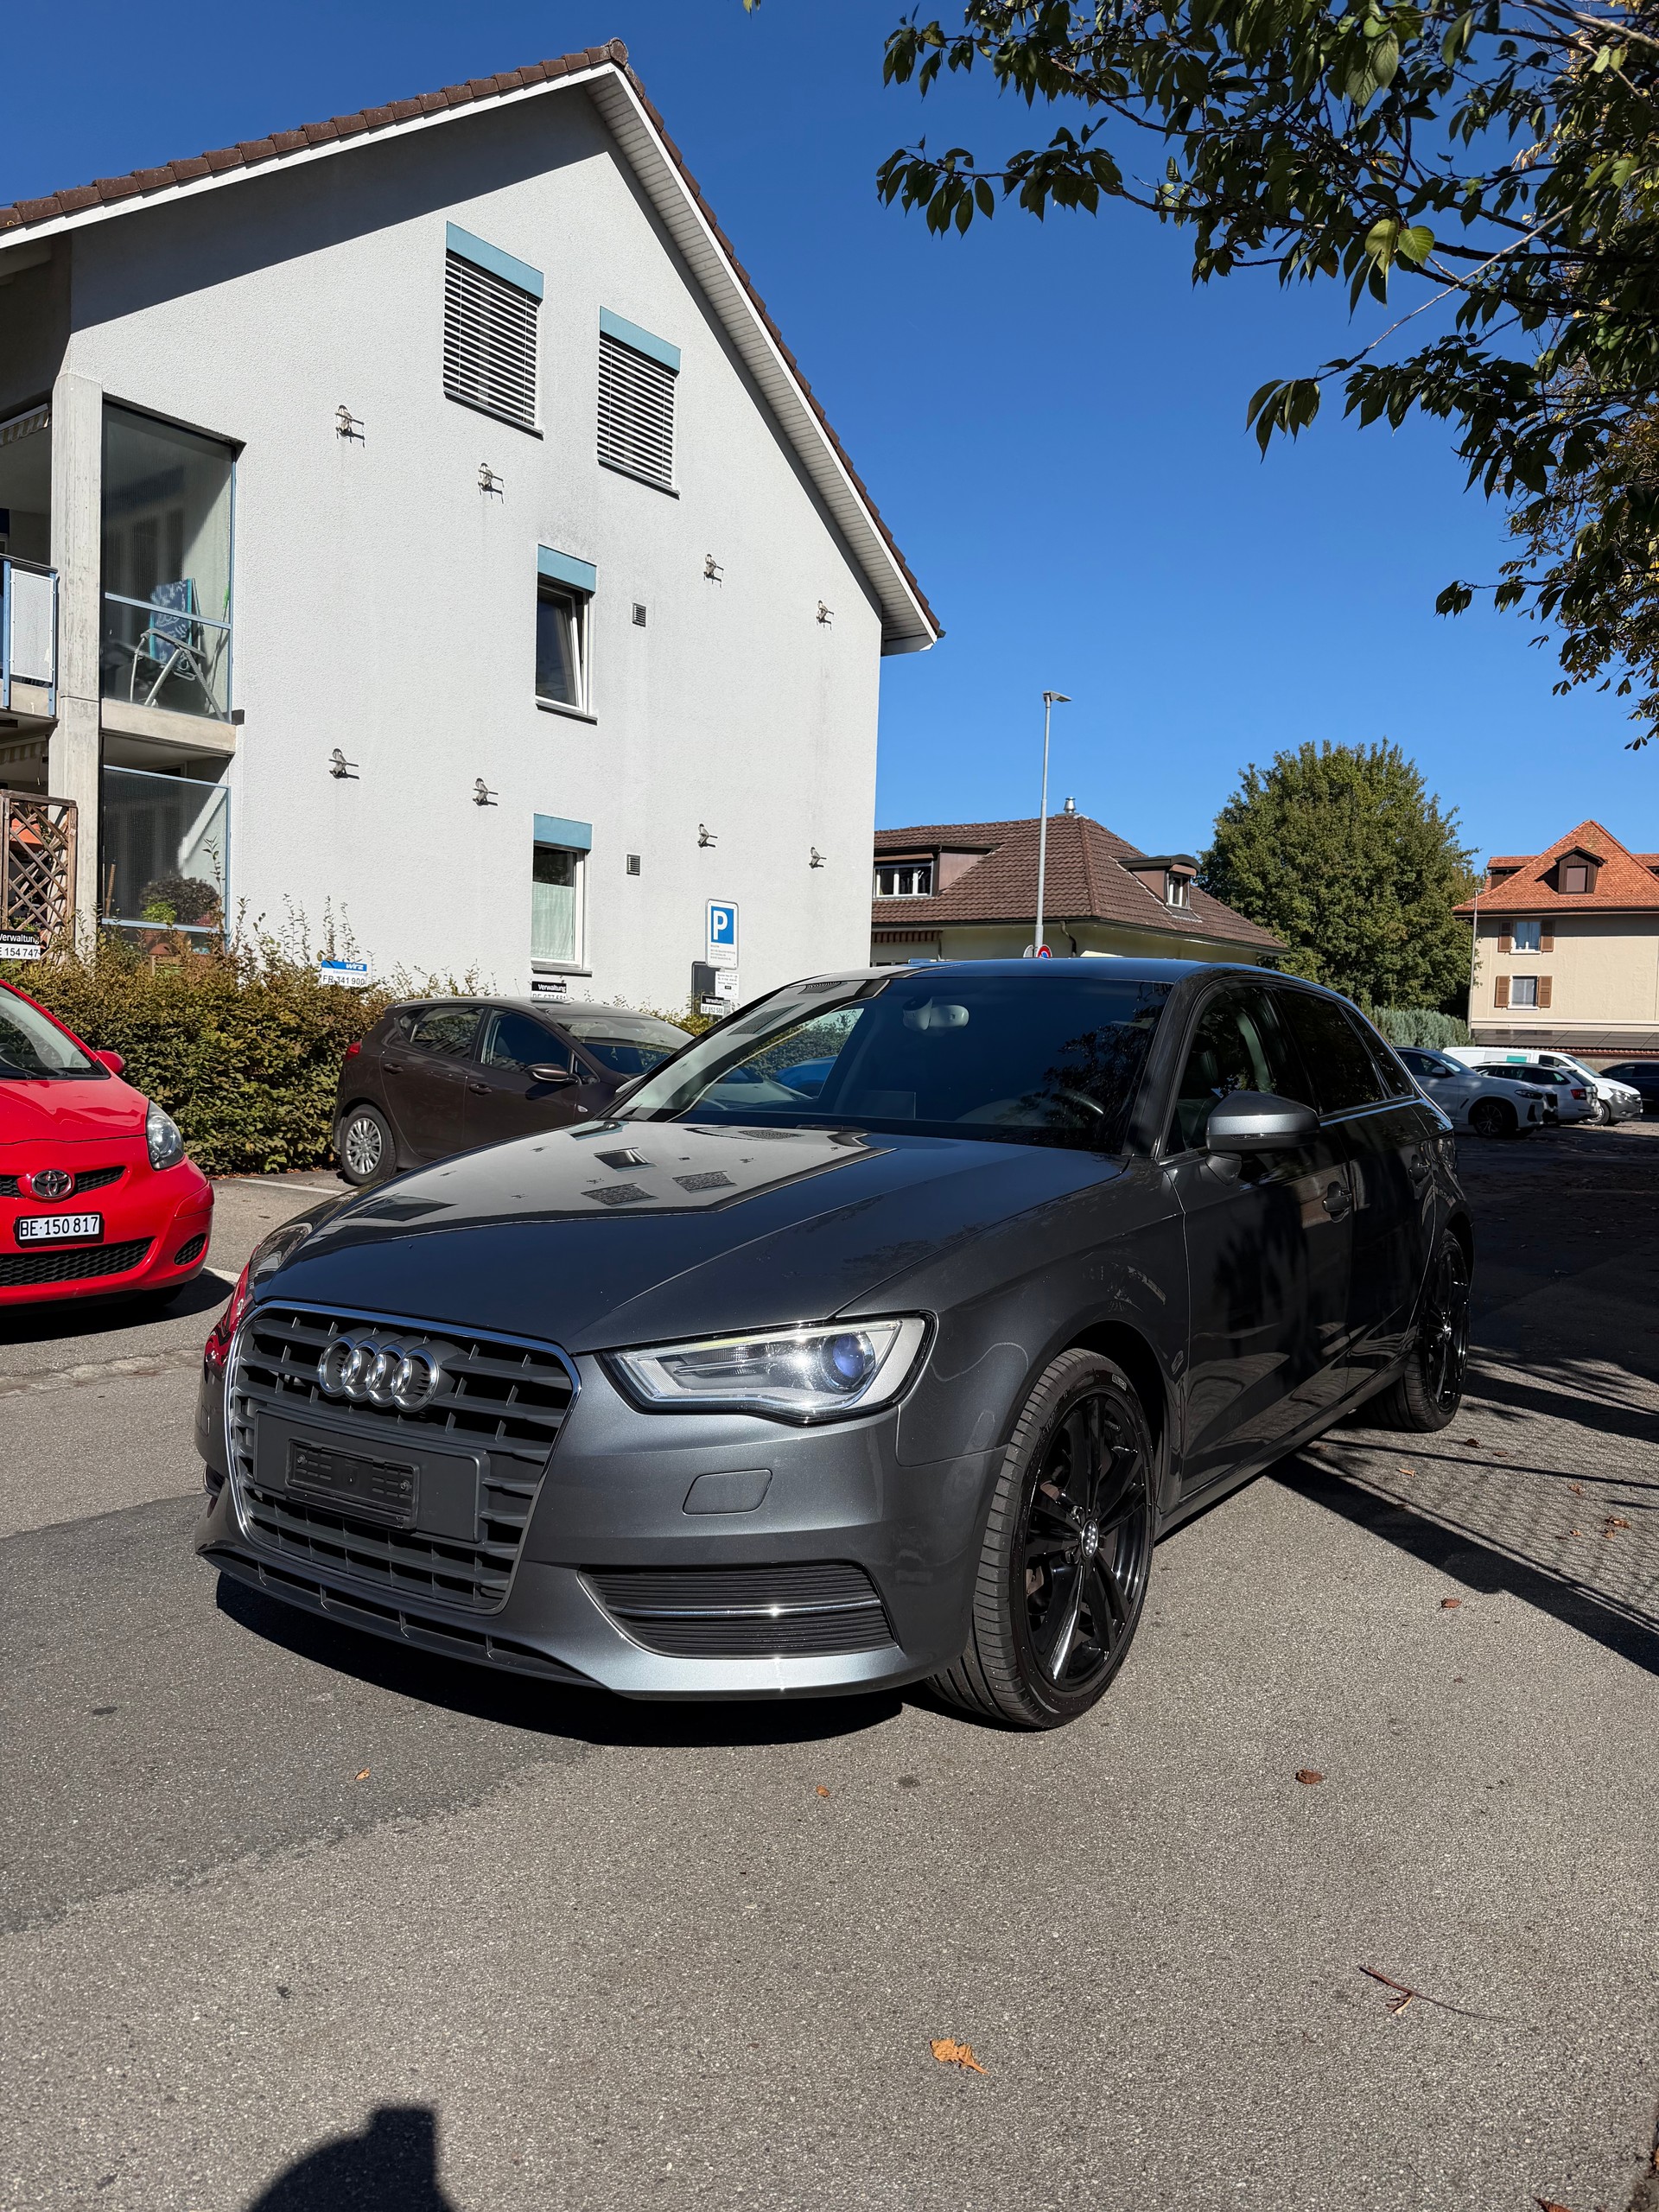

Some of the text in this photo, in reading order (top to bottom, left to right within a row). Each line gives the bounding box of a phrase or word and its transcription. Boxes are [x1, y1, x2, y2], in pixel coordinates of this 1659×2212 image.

[713, 910, 728, 940] P
[4, 947, 21, 957] 154
[22, 949, 39, 957] 747
[537, 983, 566, 993] Verwaltung
